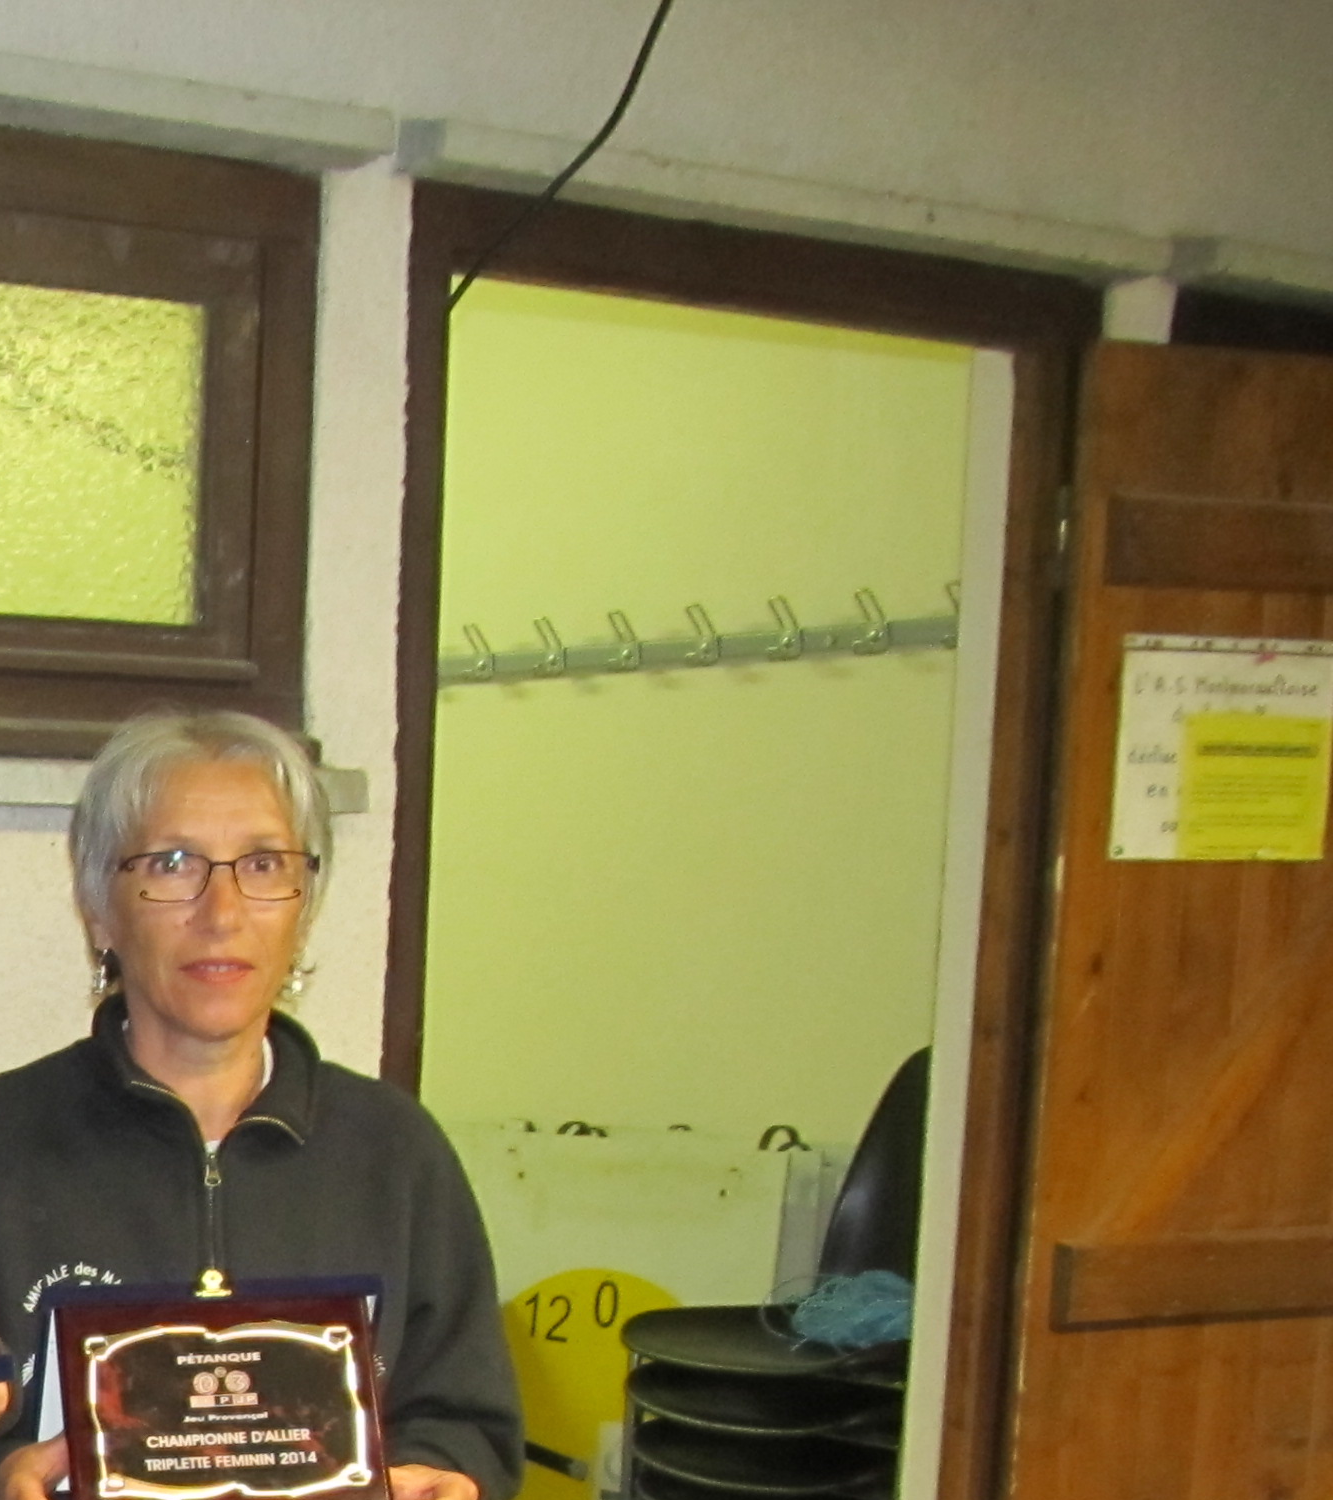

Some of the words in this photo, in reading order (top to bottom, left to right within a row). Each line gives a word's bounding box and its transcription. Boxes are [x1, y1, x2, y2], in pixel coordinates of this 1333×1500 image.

[74, 1261, 98, 1277] des
[595, 1280, 618, 1328] 0
[525, 1292, 571, 1343] 12
[177, 1352, 261, 1365] PÉTANQUE
[183, 1415, 205, 1423] Jeu
[146, 1431, 247, 1448] CHAMPIONNE
[251, 1429, 311, 1443] D'ALLIER
[145, 1456, 211, 1471] TRIPLETTE
[215, 1453, 275, 1468] FEMININ
[279, 1451, 318, 1464] 2014
